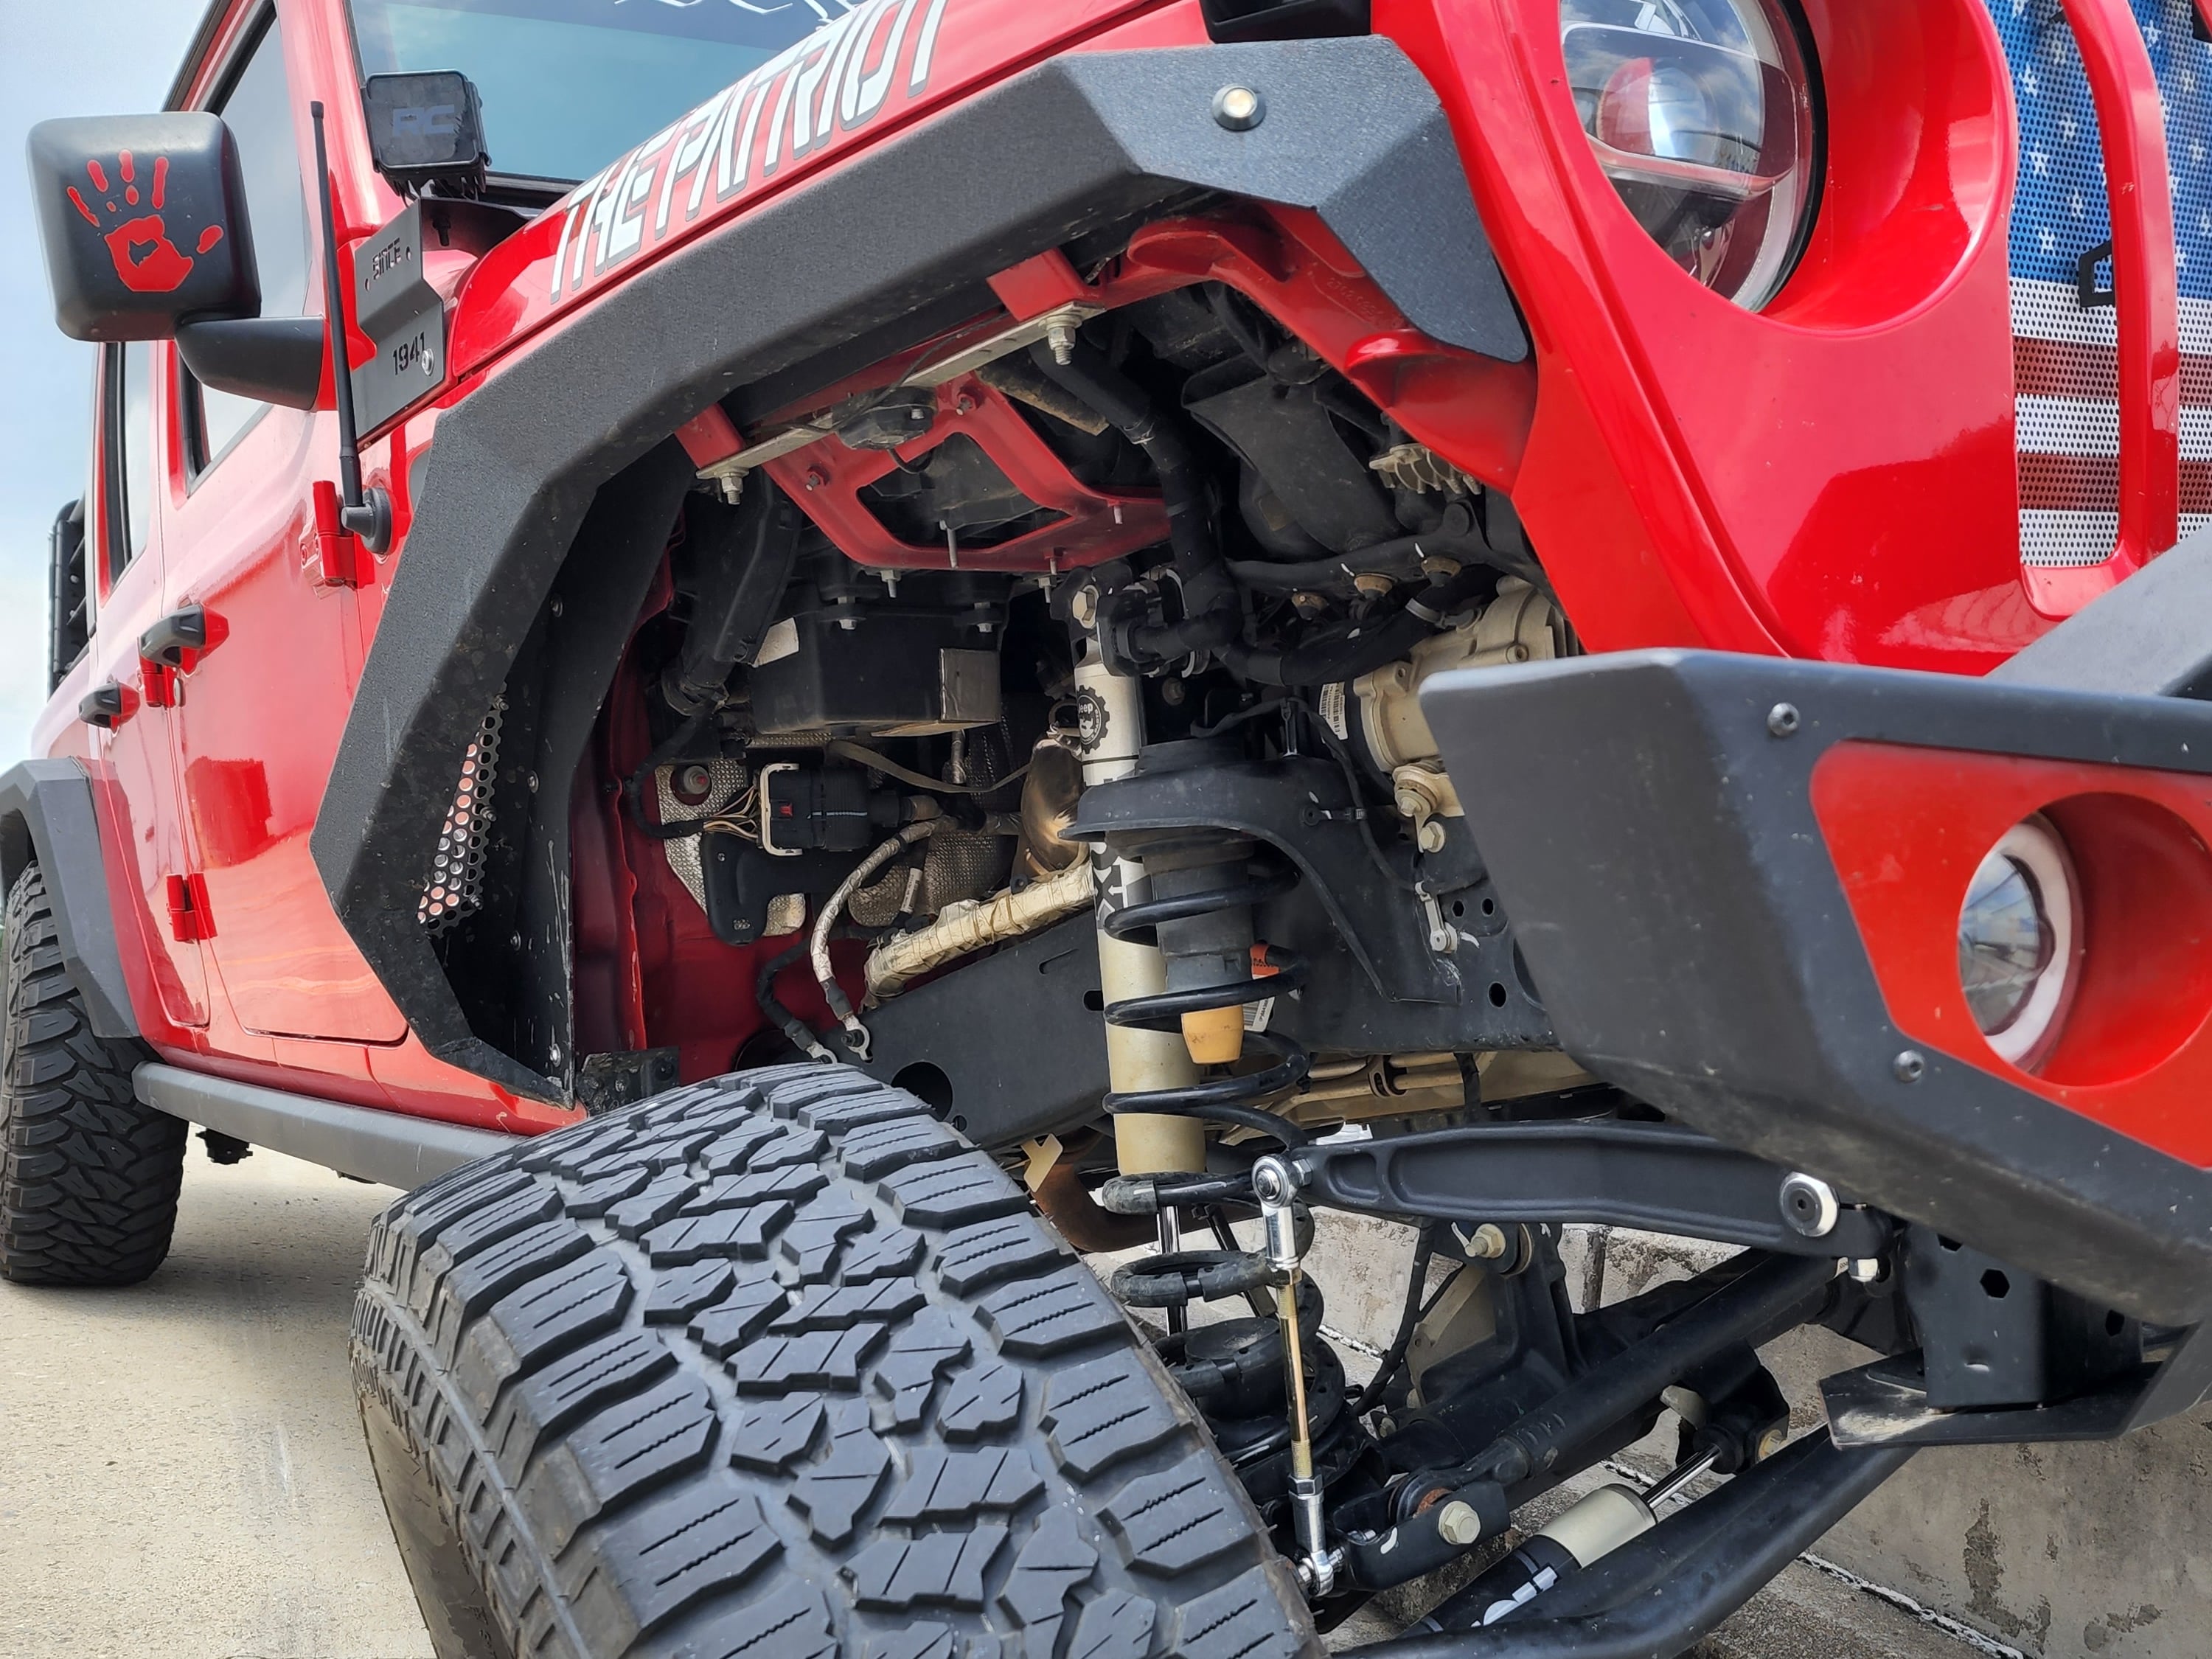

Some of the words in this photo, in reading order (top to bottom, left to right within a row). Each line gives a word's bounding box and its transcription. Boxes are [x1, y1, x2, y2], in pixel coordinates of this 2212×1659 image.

[393, 105, 455, 136] RC
[550, 120, 684, 305] THE
[372, 237, 401, 280] SINCE
[392, 331, 425, 375] 1941
